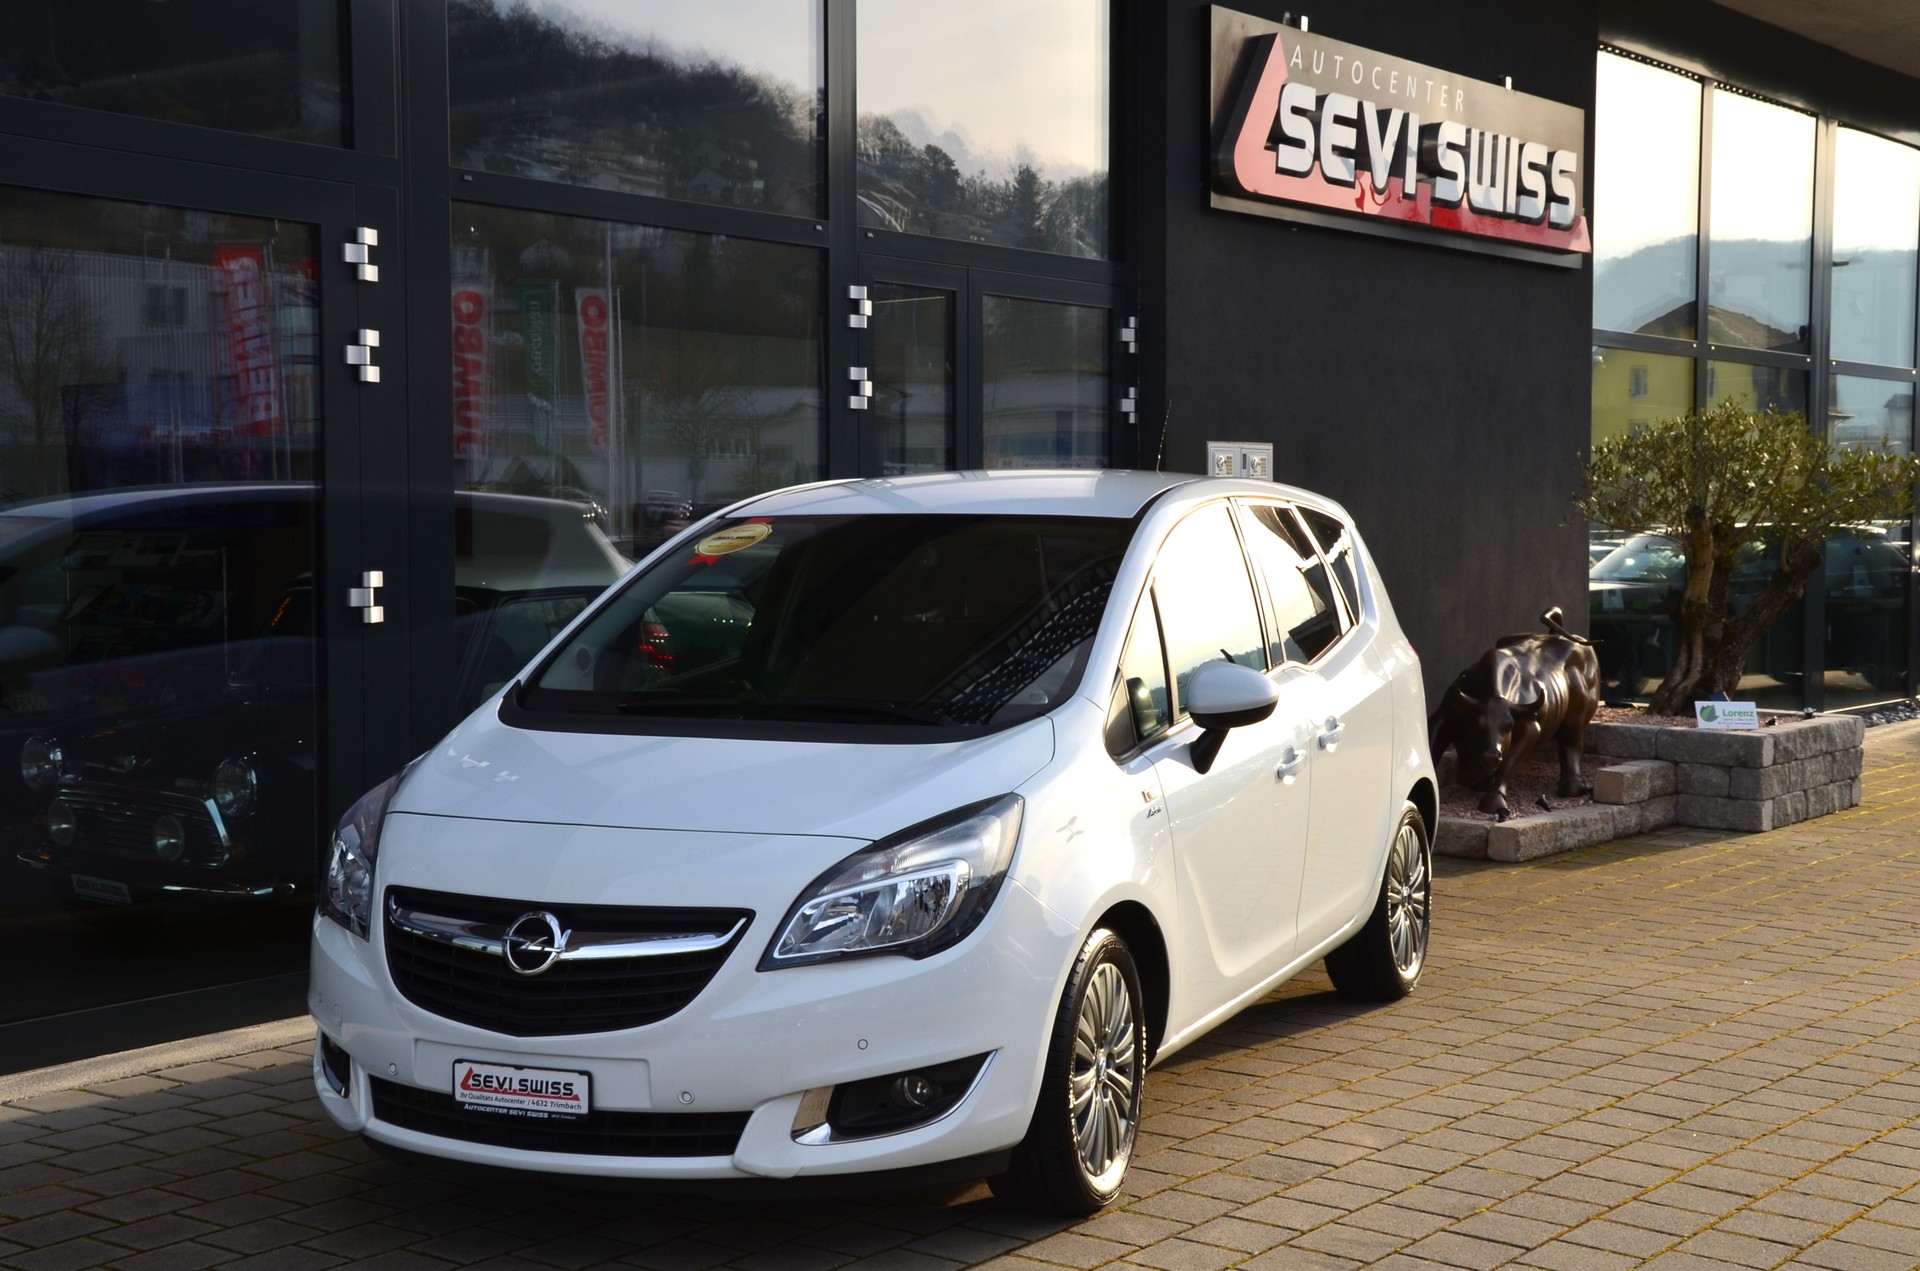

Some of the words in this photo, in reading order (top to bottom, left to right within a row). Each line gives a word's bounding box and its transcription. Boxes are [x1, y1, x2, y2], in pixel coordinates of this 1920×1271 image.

[1290, 44, 1465, 112] AUTOCENTER
[1276, 82, 1420, 194] SEVI
[1435, 121, 1578, 227] SWISS
[1722, 709, 1754, 717] Lorenz
[471, 1074, 512, 1091] SEVI
[518, 1078, 574, 1096] SWISS
[494, 1096, 526, 1105] Autocenter
[550, 1101, 582, 1110] Trimbach
[508, 1109, 526, 1117] SEVI
[527, 1111, 549, 1119] SWISS
